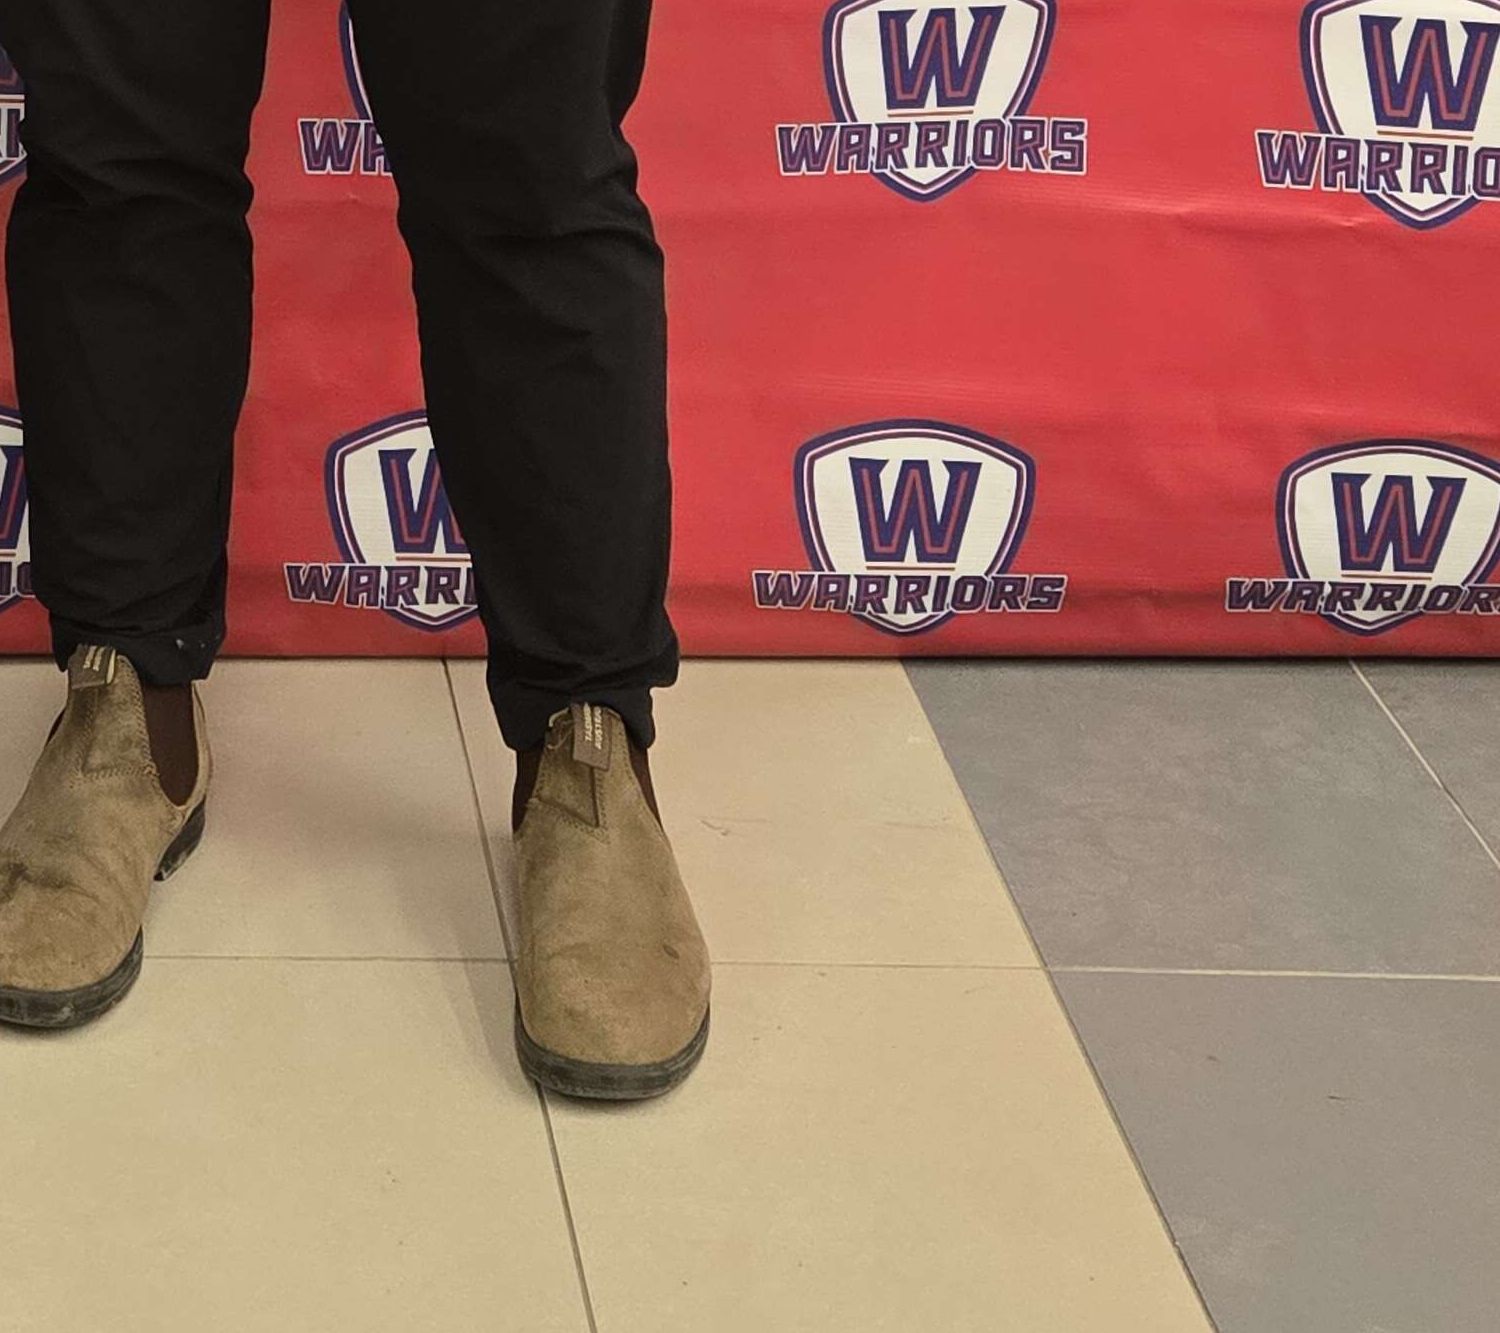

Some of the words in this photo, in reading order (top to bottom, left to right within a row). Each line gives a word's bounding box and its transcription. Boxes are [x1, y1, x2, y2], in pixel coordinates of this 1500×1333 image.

[878, 5, 1006, 110] W
[1359, 14, 1500, 132] W
[775, 117, 1088, 176] WARRIORS
[849, 457, 981, 564] W
[1331, 472, 1467, 573] W
[752, 570, 1068, 614] WARRIORS
